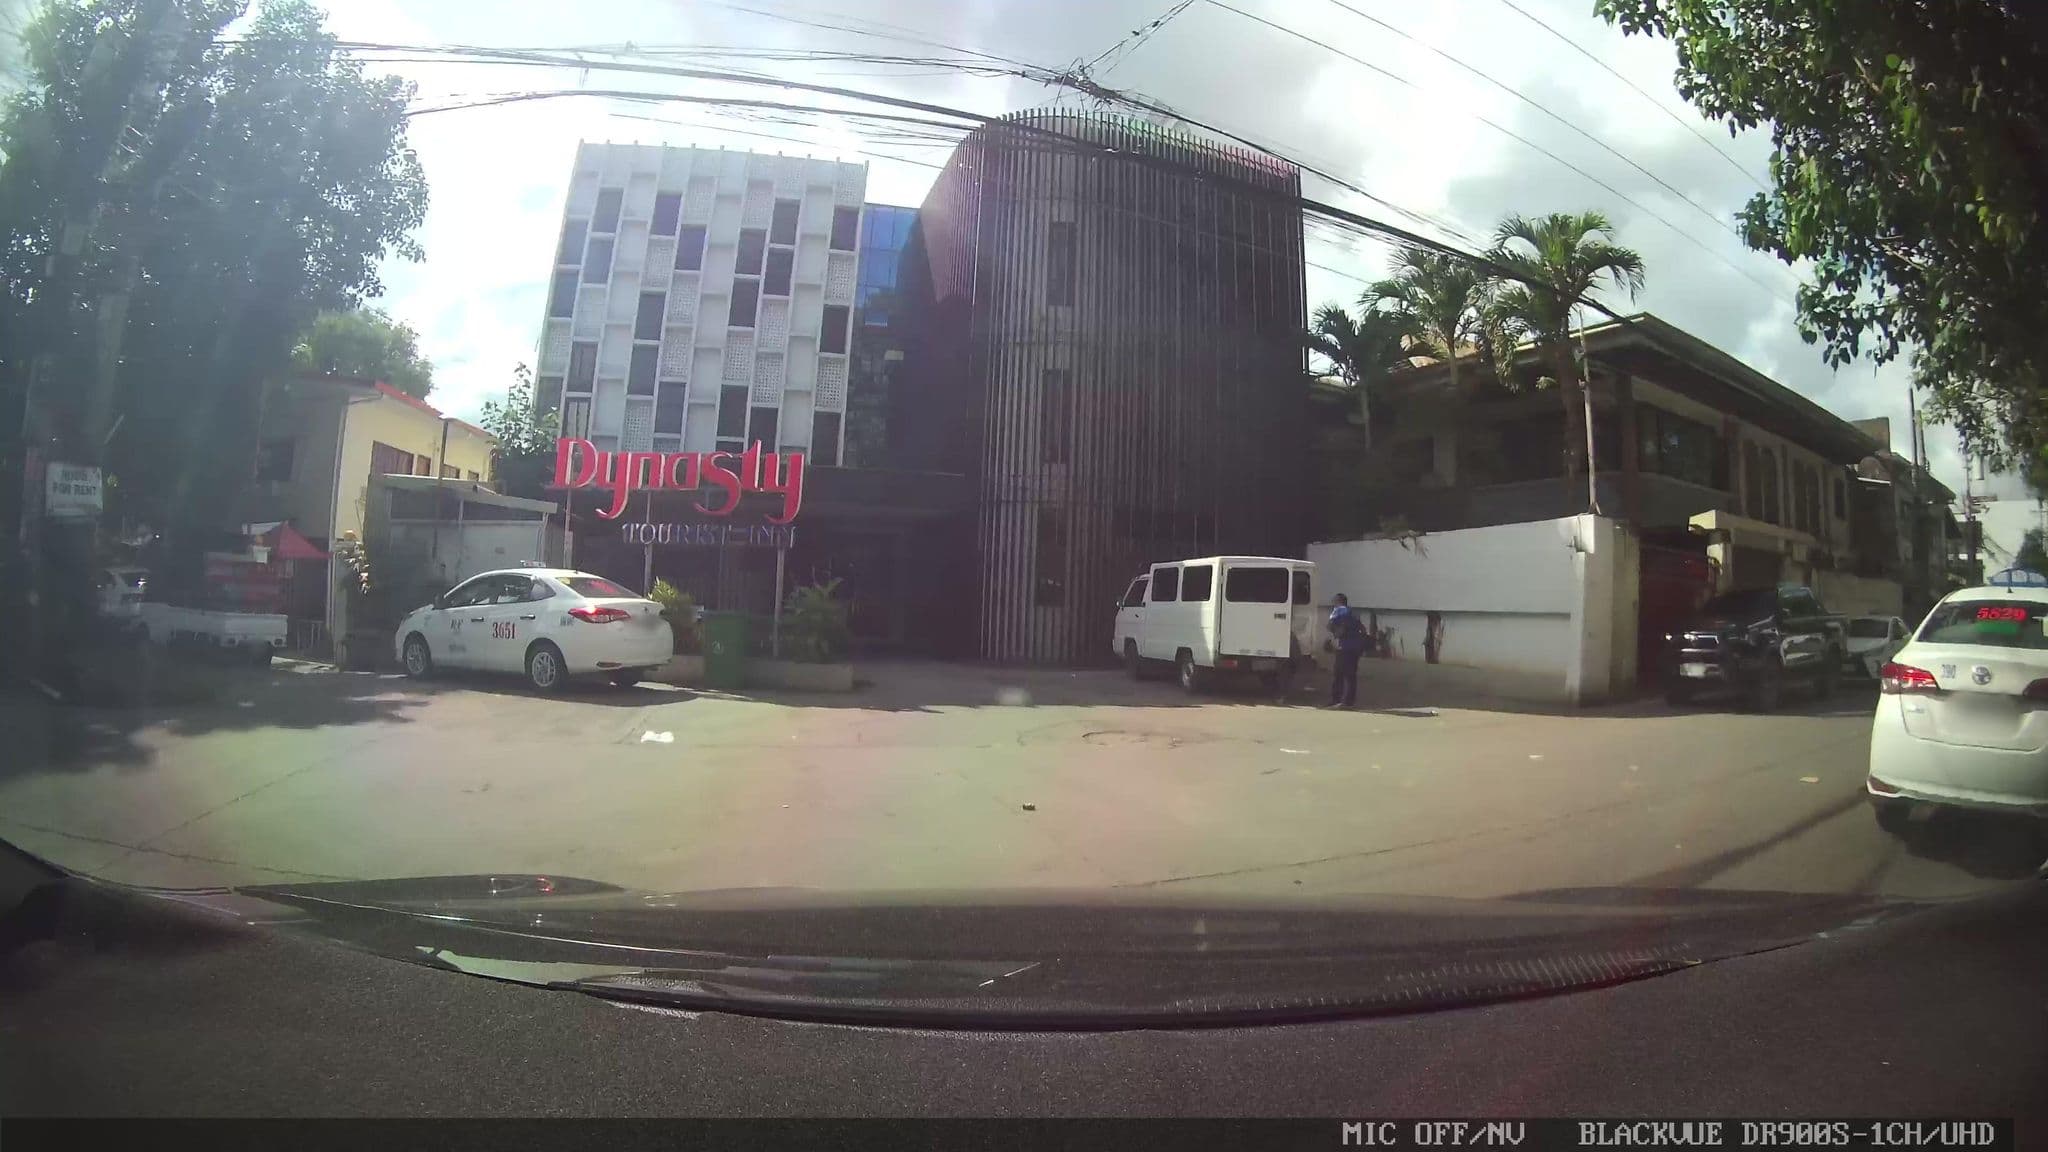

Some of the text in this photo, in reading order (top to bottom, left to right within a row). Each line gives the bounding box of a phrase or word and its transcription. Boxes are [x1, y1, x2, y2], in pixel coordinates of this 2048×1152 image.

[553, 437, 805, 524] Dynasty
[622, 523, 736, 545] TOURIST
[491, 621, 516, 640] 3651
